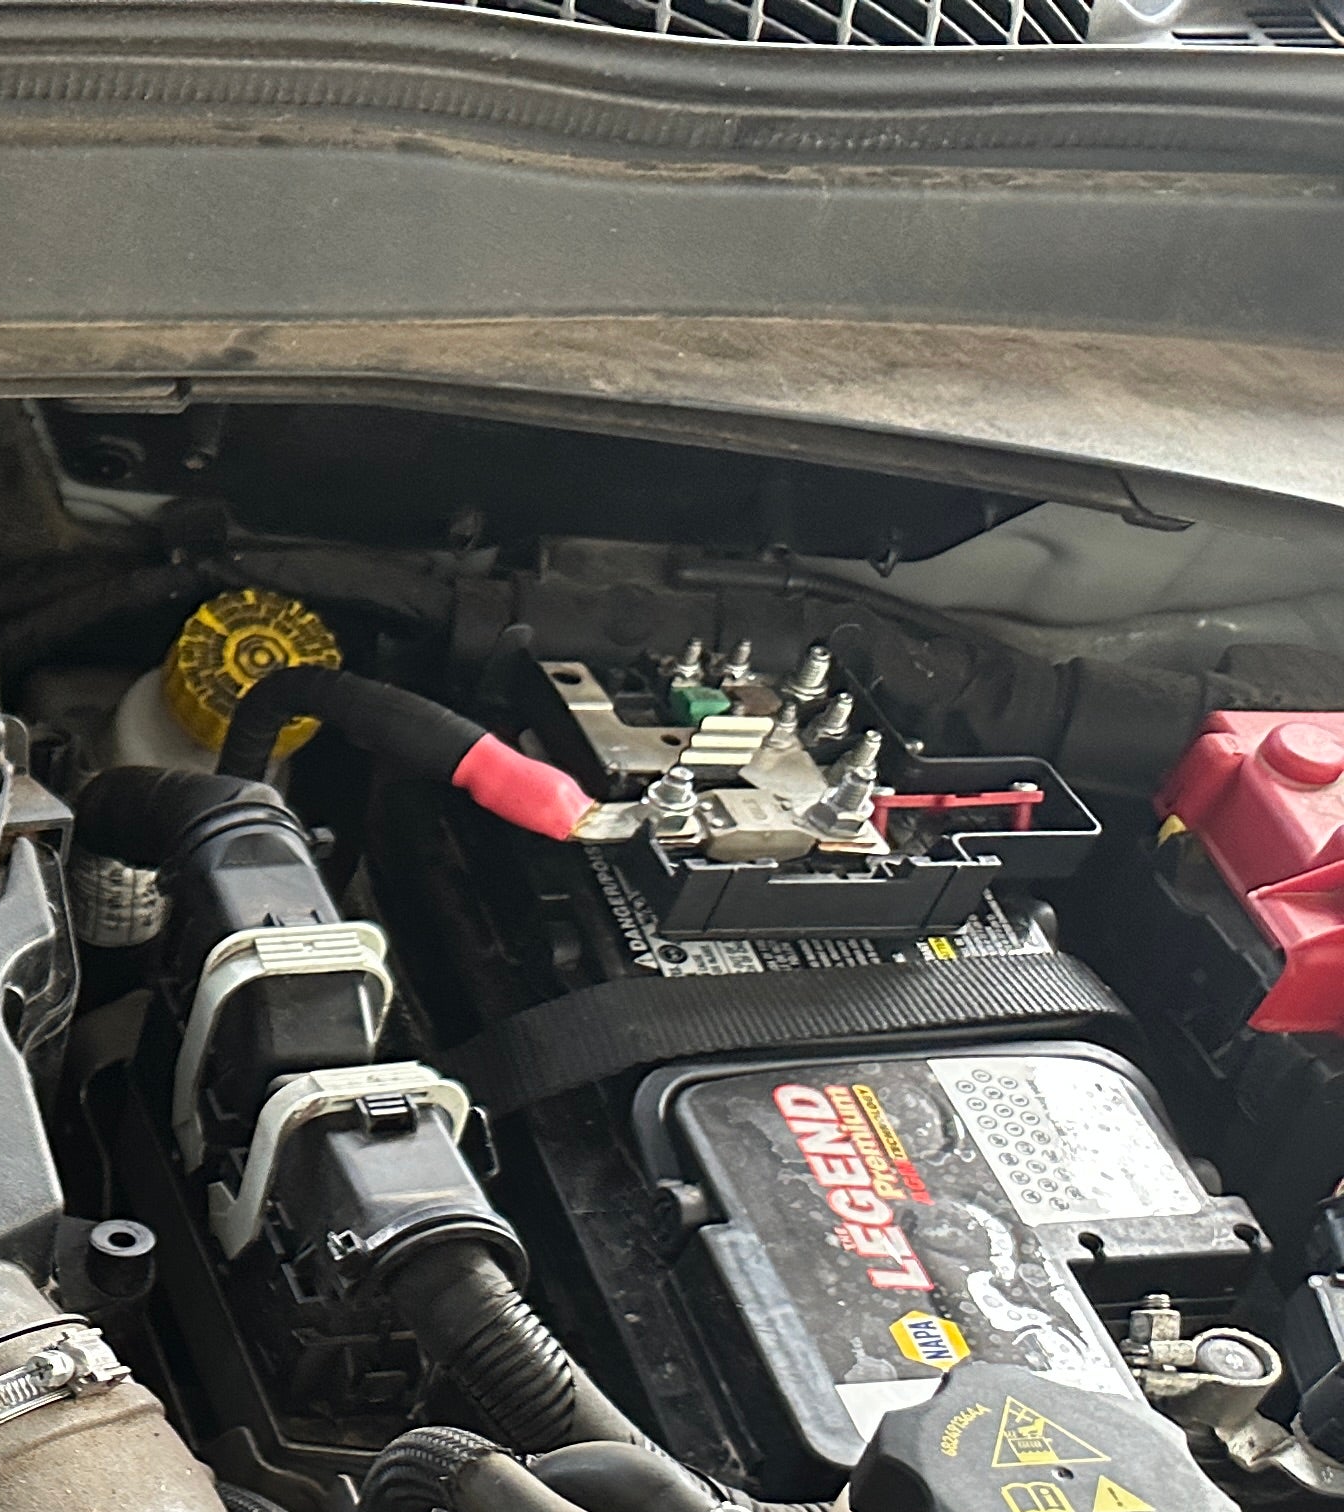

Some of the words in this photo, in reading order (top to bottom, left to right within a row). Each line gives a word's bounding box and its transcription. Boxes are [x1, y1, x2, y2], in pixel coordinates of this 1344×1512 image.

[585, 847, 648, 951] DANGER/POIS
[773, 1084, 935, 1291] LEGEND
[824, 1085, 907, 1200] Premium
[893, 1159, 936, 1206] AGM
[908, 1319, 953, 1360] NAPA
